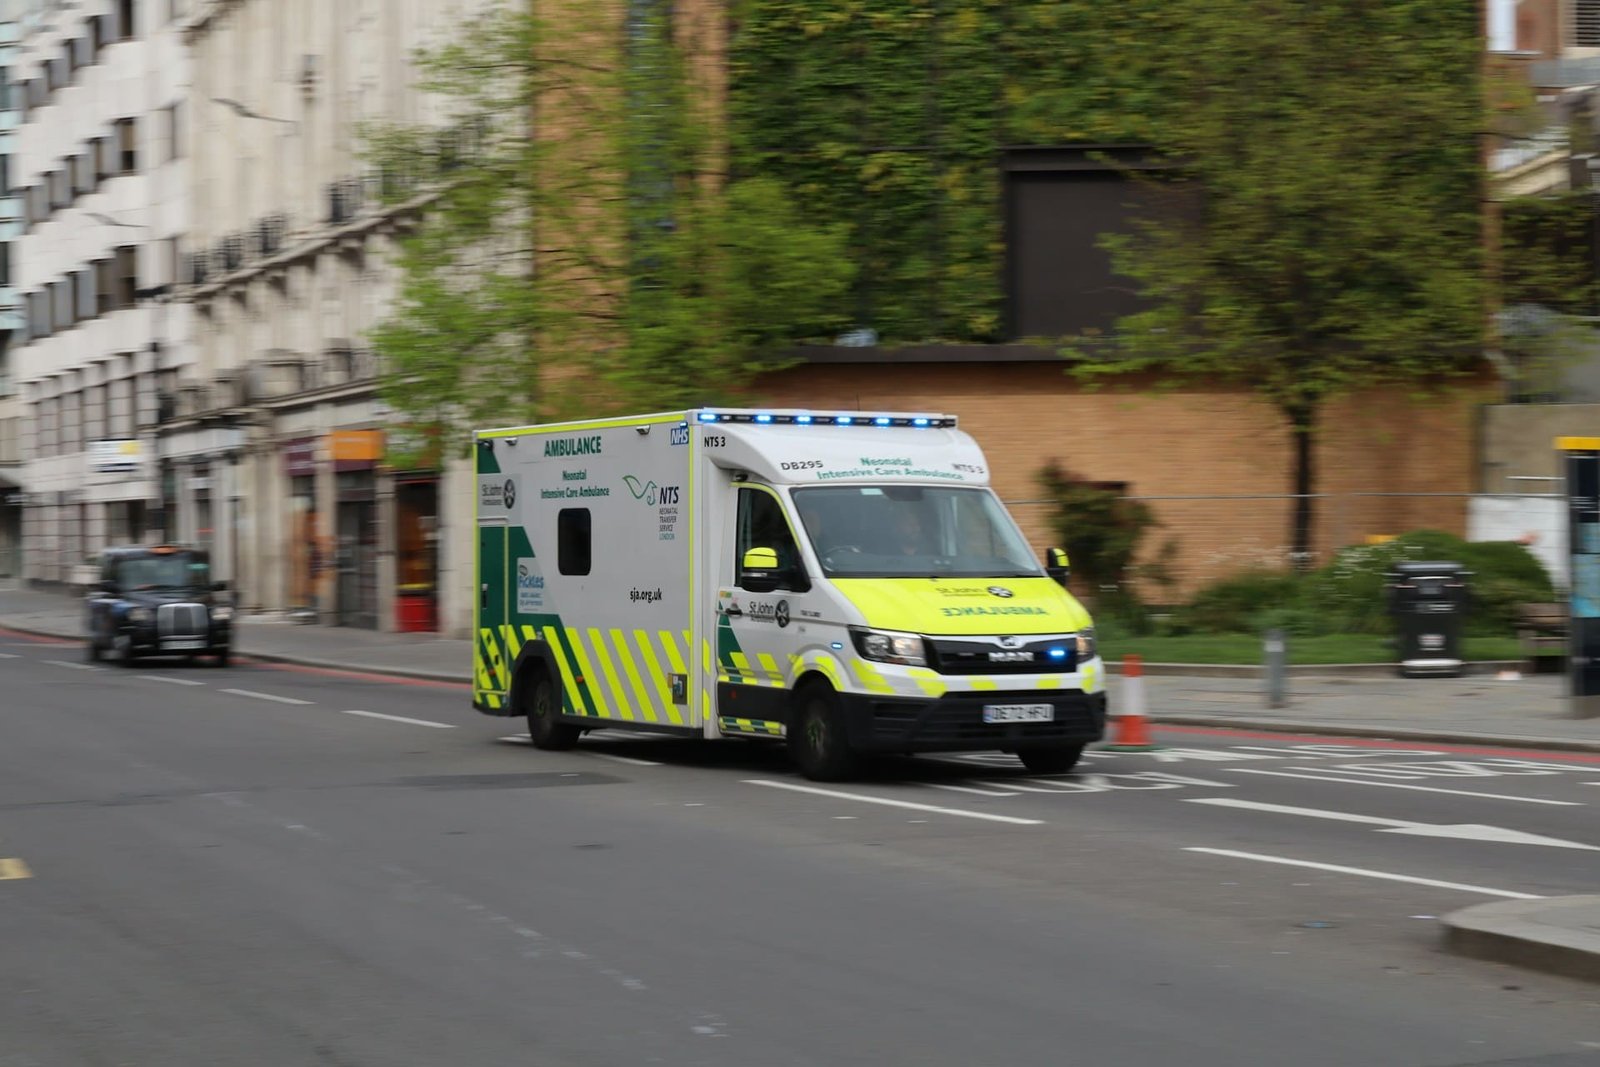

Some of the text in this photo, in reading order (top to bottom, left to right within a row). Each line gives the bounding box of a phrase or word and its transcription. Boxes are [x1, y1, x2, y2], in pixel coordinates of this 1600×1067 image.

[671, 429, 688, 444] NHS
[704, 436, 726, 448] NTS 3
[544, 436, 602, 457] AMBULANCE
[780, 460, 824, 471] DB295
[860, 457, 912, 467] Neonatal
[952, 463, 985, 474] NTS 3
[562, 469, 587, 481] Neonatal
[816, 467, 965, 481] Intensive Care Ambulance
[541, 485, 610, 500] Intensive Care Ambulance
[659, 486, 680, 504] NTS
[630, 586, 663, 604] sja.org.uk
[988, 651, 1034, 662] MAN
